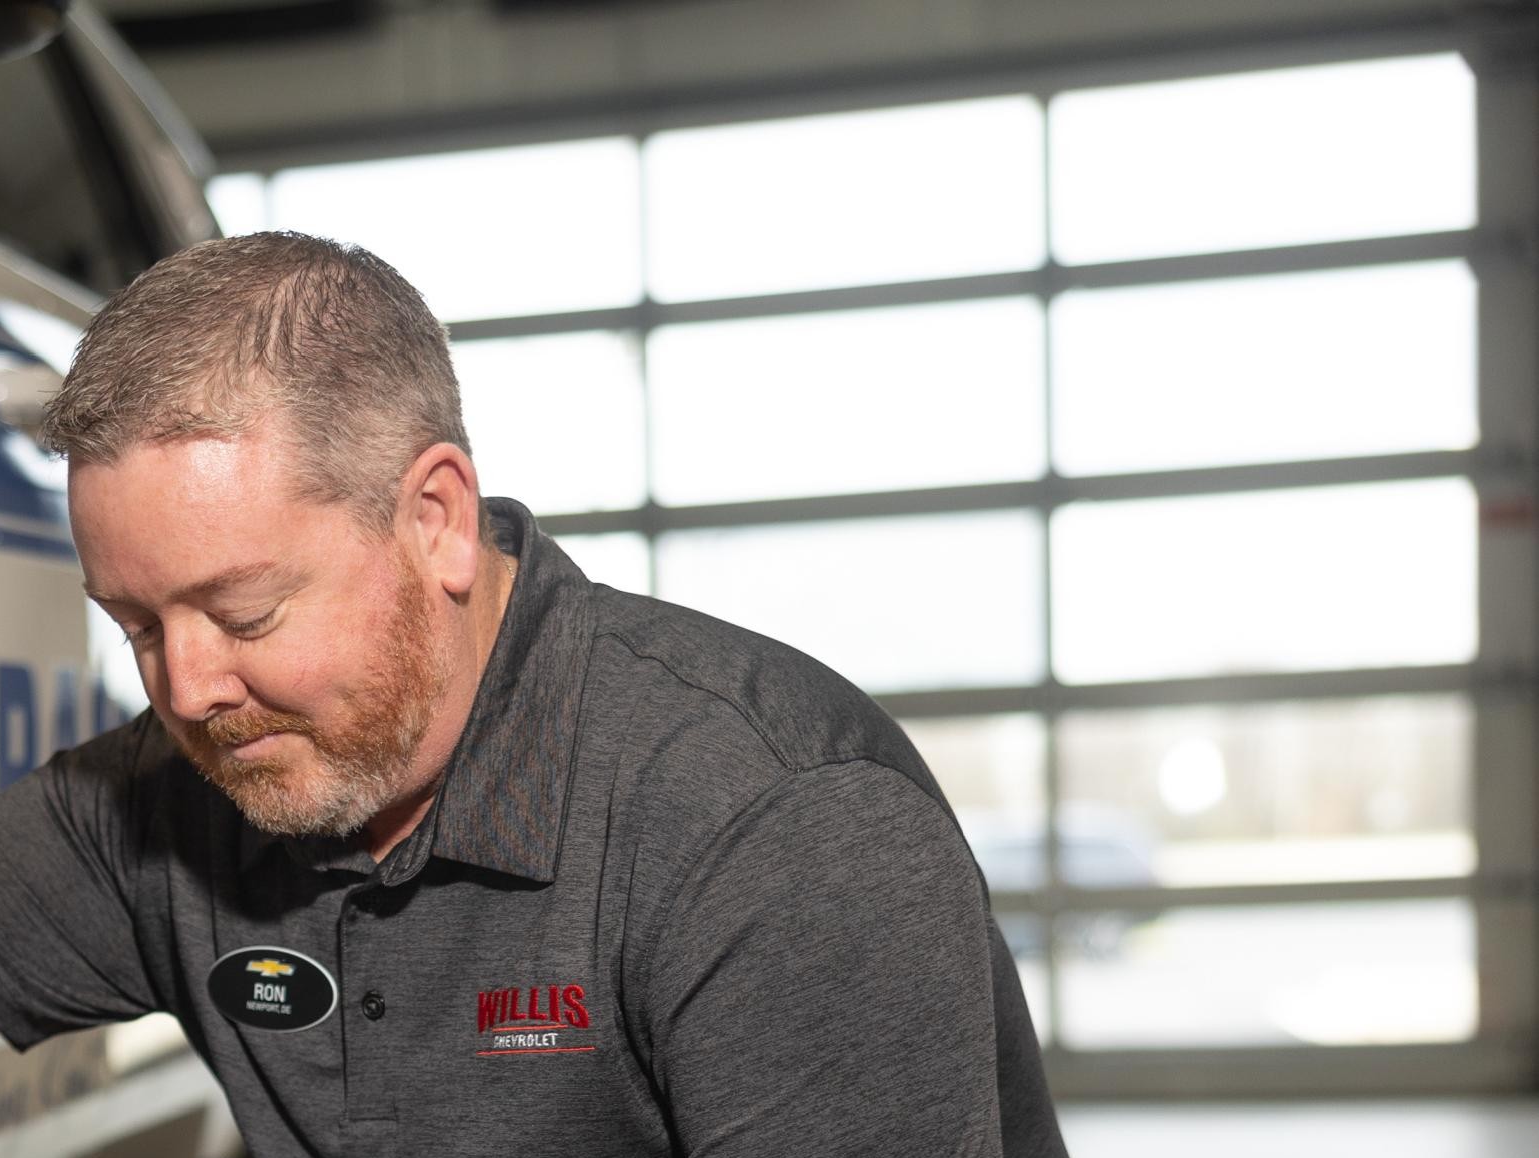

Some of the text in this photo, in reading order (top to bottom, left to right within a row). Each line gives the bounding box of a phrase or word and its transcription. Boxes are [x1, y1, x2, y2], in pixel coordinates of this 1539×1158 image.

[253, 982, 287, 1003] RON
[477, 984, 590, 1033] WILLIS
[493, 1032, 559, 1048] CHEVROLET
